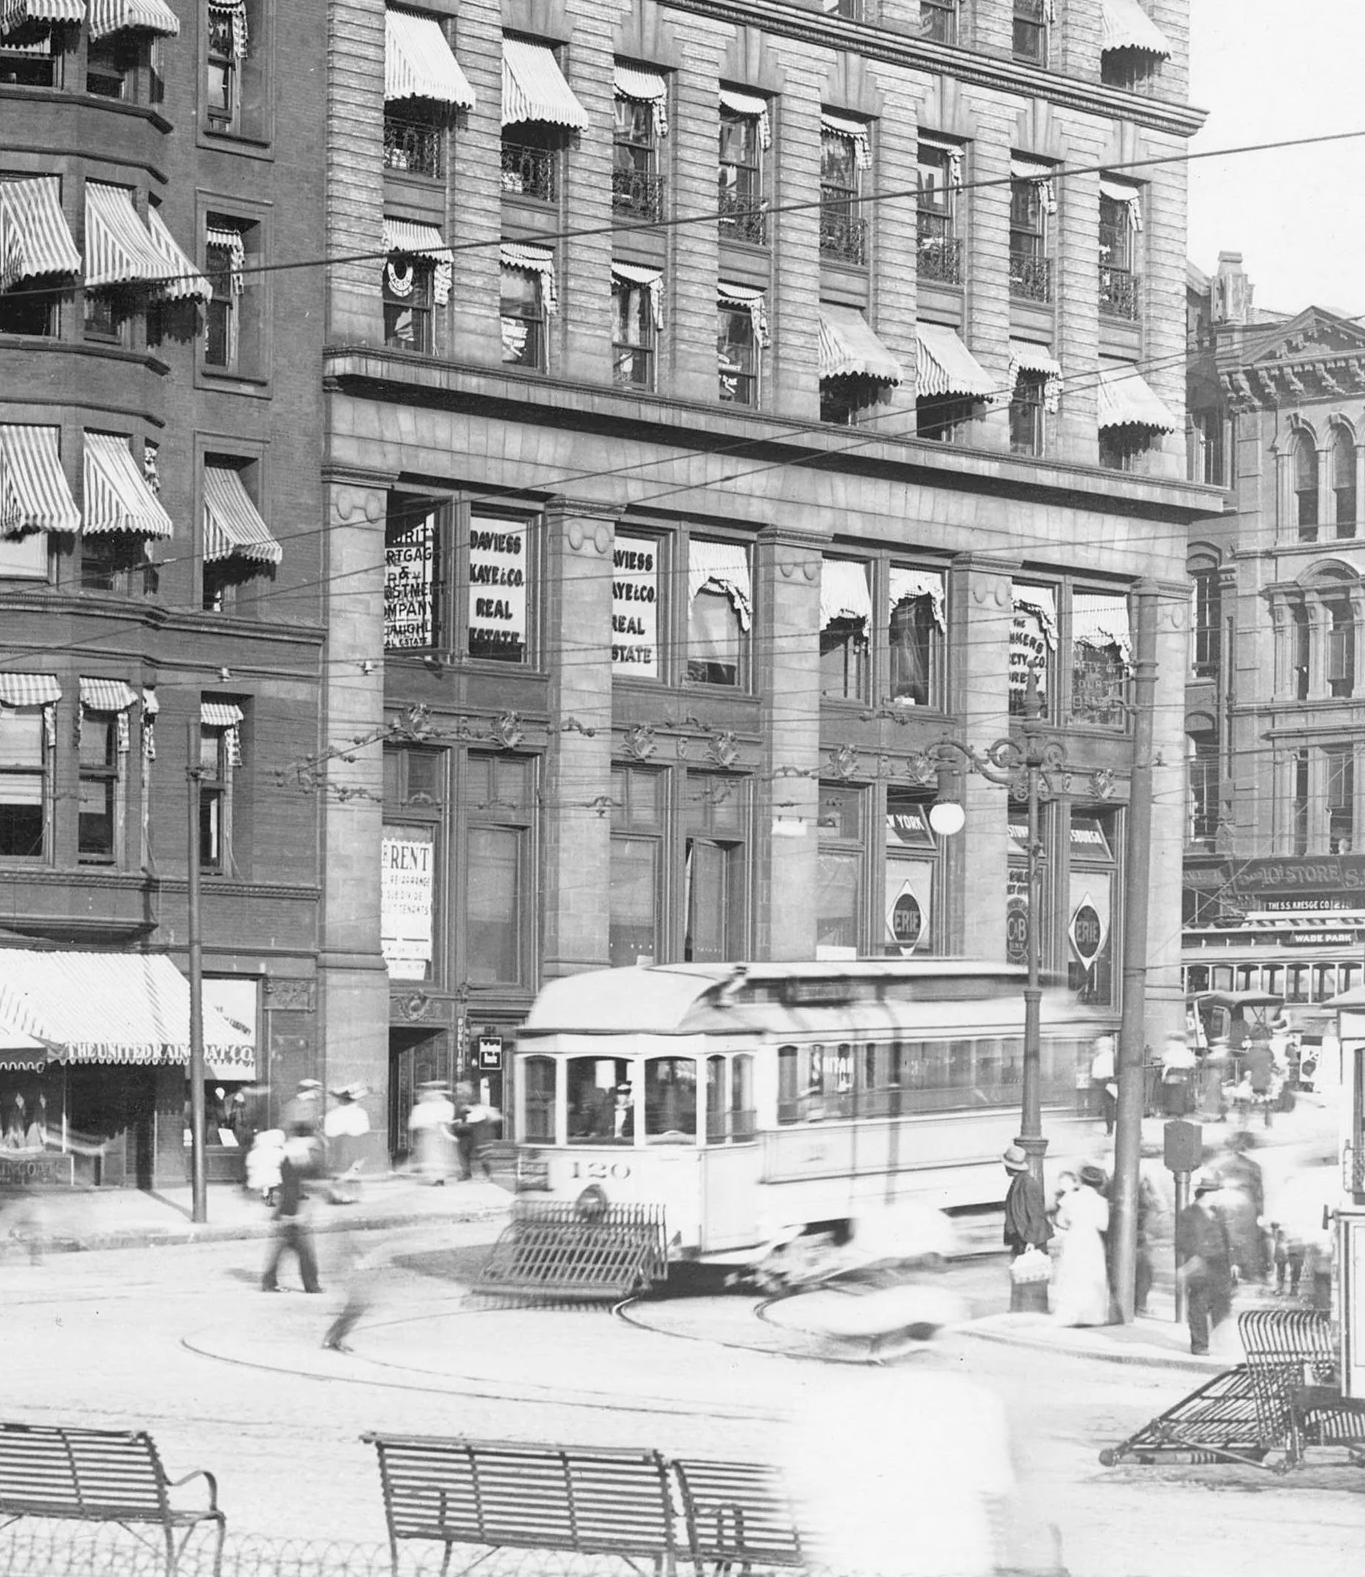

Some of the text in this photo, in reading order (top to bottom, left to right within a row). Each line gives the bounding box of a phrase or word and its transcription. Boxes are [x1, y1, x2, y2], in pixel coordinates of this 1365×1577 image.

[469, 529, 522, 555] DAVIESS
[613, 549, 654, 572] AVIESS
[469, 562, 500, 585] KAYE
[612, 581, 633, 602] AYE
[475, 597, 513, 620] REAL
[612, 644, 653, 665] STATE
[1009, 632, 1044, 655] NKERS
[390, 844, 430, 872] RENT
[1293, 900, 1318, 911] KRESGE
[894, 909, 920, 933] ERIE
[1075, 920, 1100, 944] ERIE
[1294, 933, 1352, 943] WADE PARK
[66, 1041, 96, 1063] THE
[96, 1041, 153, 1063] UNITED
[571, 1161, 631, 1179] 120
